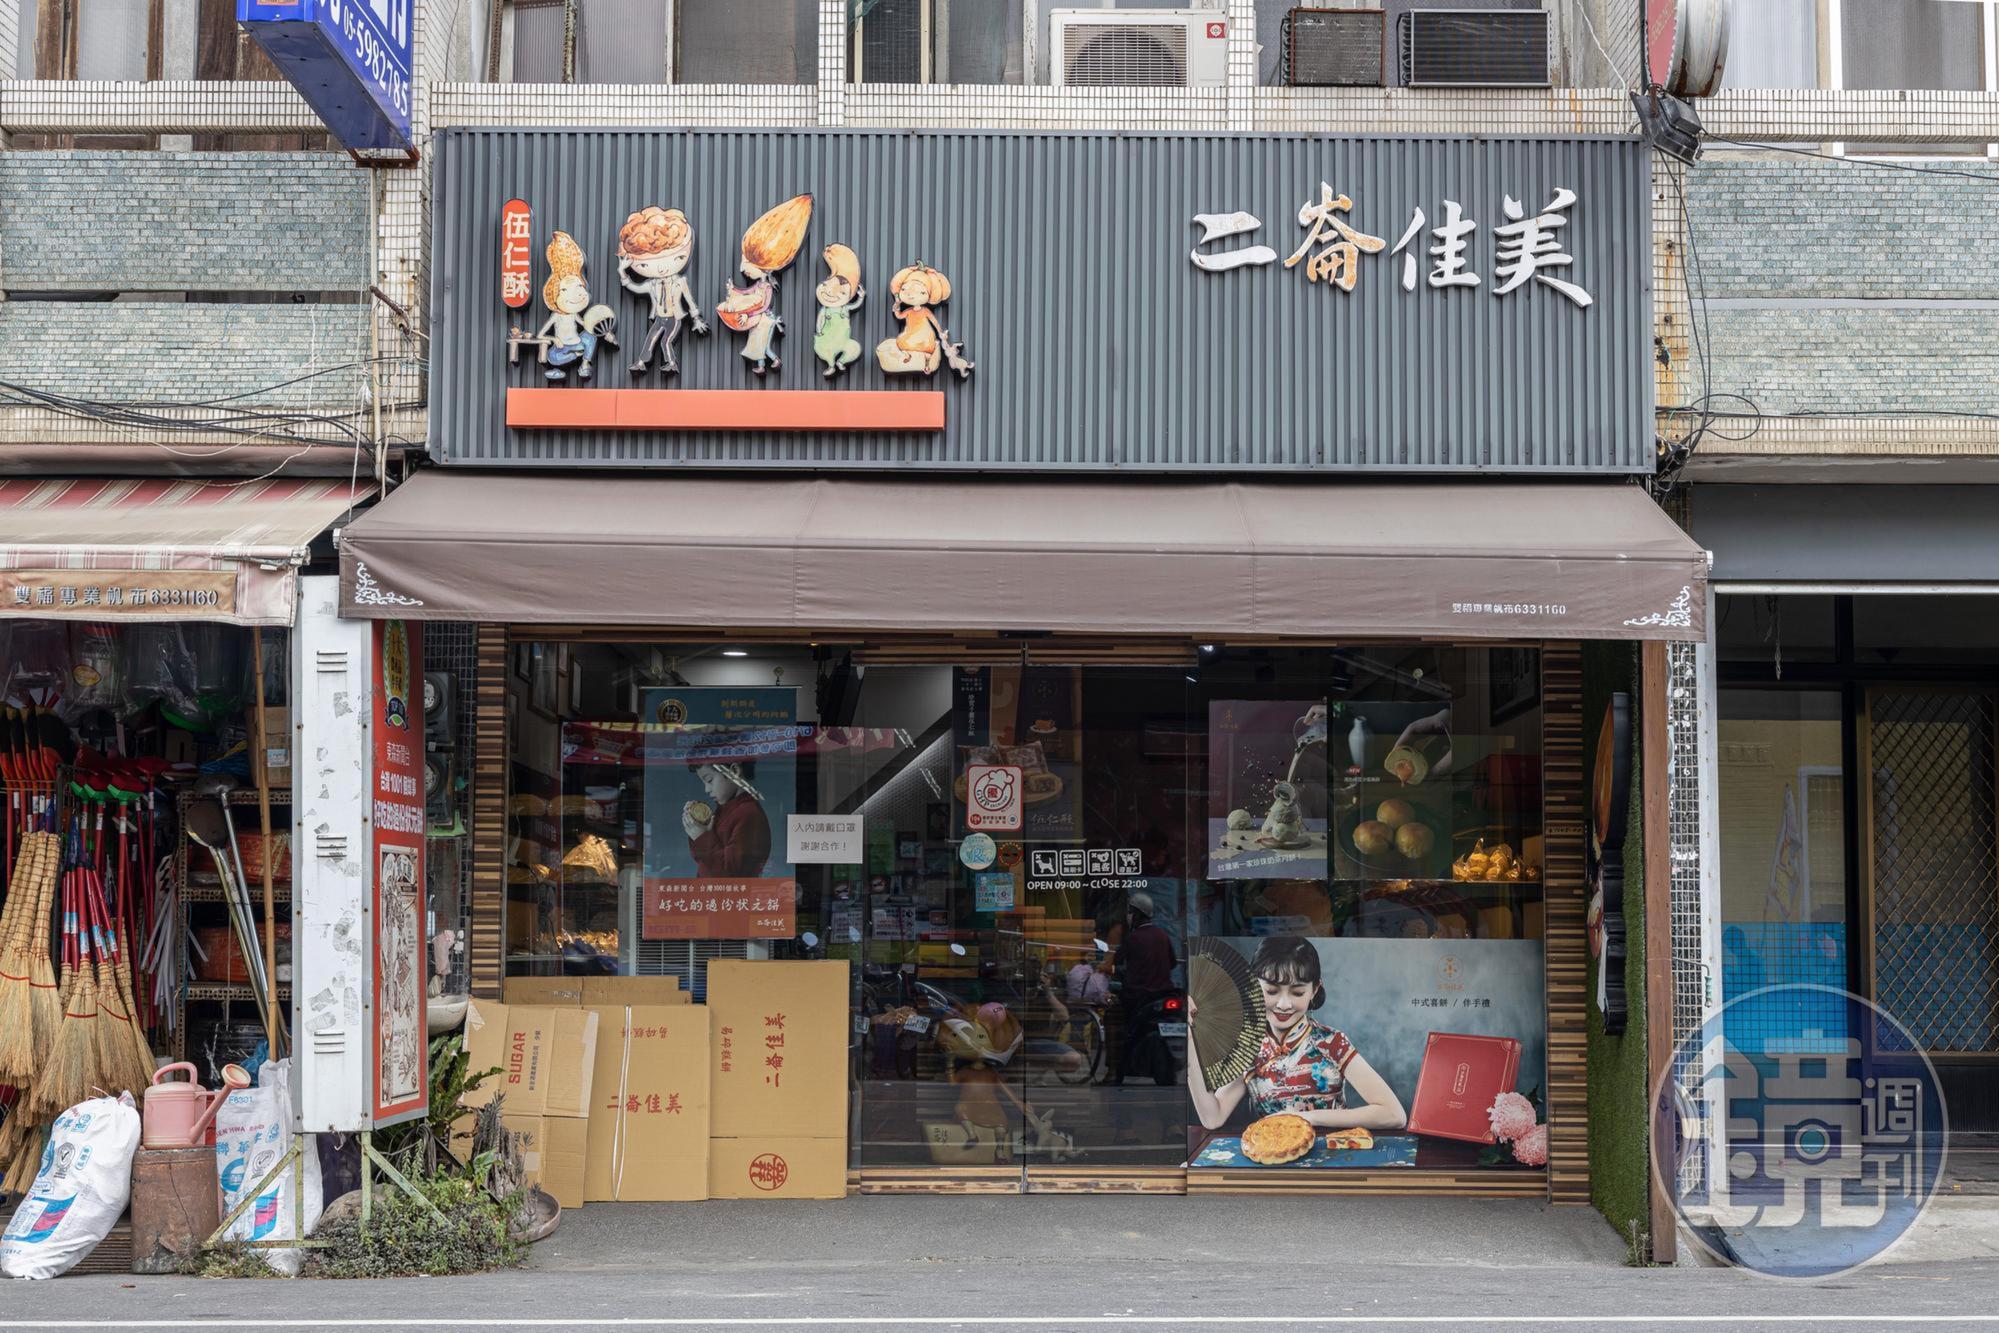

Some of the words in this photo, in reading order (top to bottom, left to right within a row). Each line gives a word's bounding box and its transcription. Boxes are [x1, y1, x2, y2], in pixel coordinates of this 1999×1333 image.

[343, 5, 409, 117] 05-5982785
[502, 210, 531, 300] 伍仁酥
[1191, 181, 1594, 309] 二崙佳美
[794, 822, 857, 833] 入內請戴口罩
[1027, 880, 1053, 890] OPEN
[1055, 880, 1081, 889] 09:00
[1090, 878, 1120, 889] CLOSE
[1122, 879, 1148, 889] 22:00
[1411, 998, 1449, 1008] 中式喜餅
[1463, 998, 1491, 1008] 伴手禮
[507, 1031, 527, 1085] SUGAR
[764, 1012, 787, 1088] 二崙佳美
[606, 1093, 683, 1115] 二崙佳美
